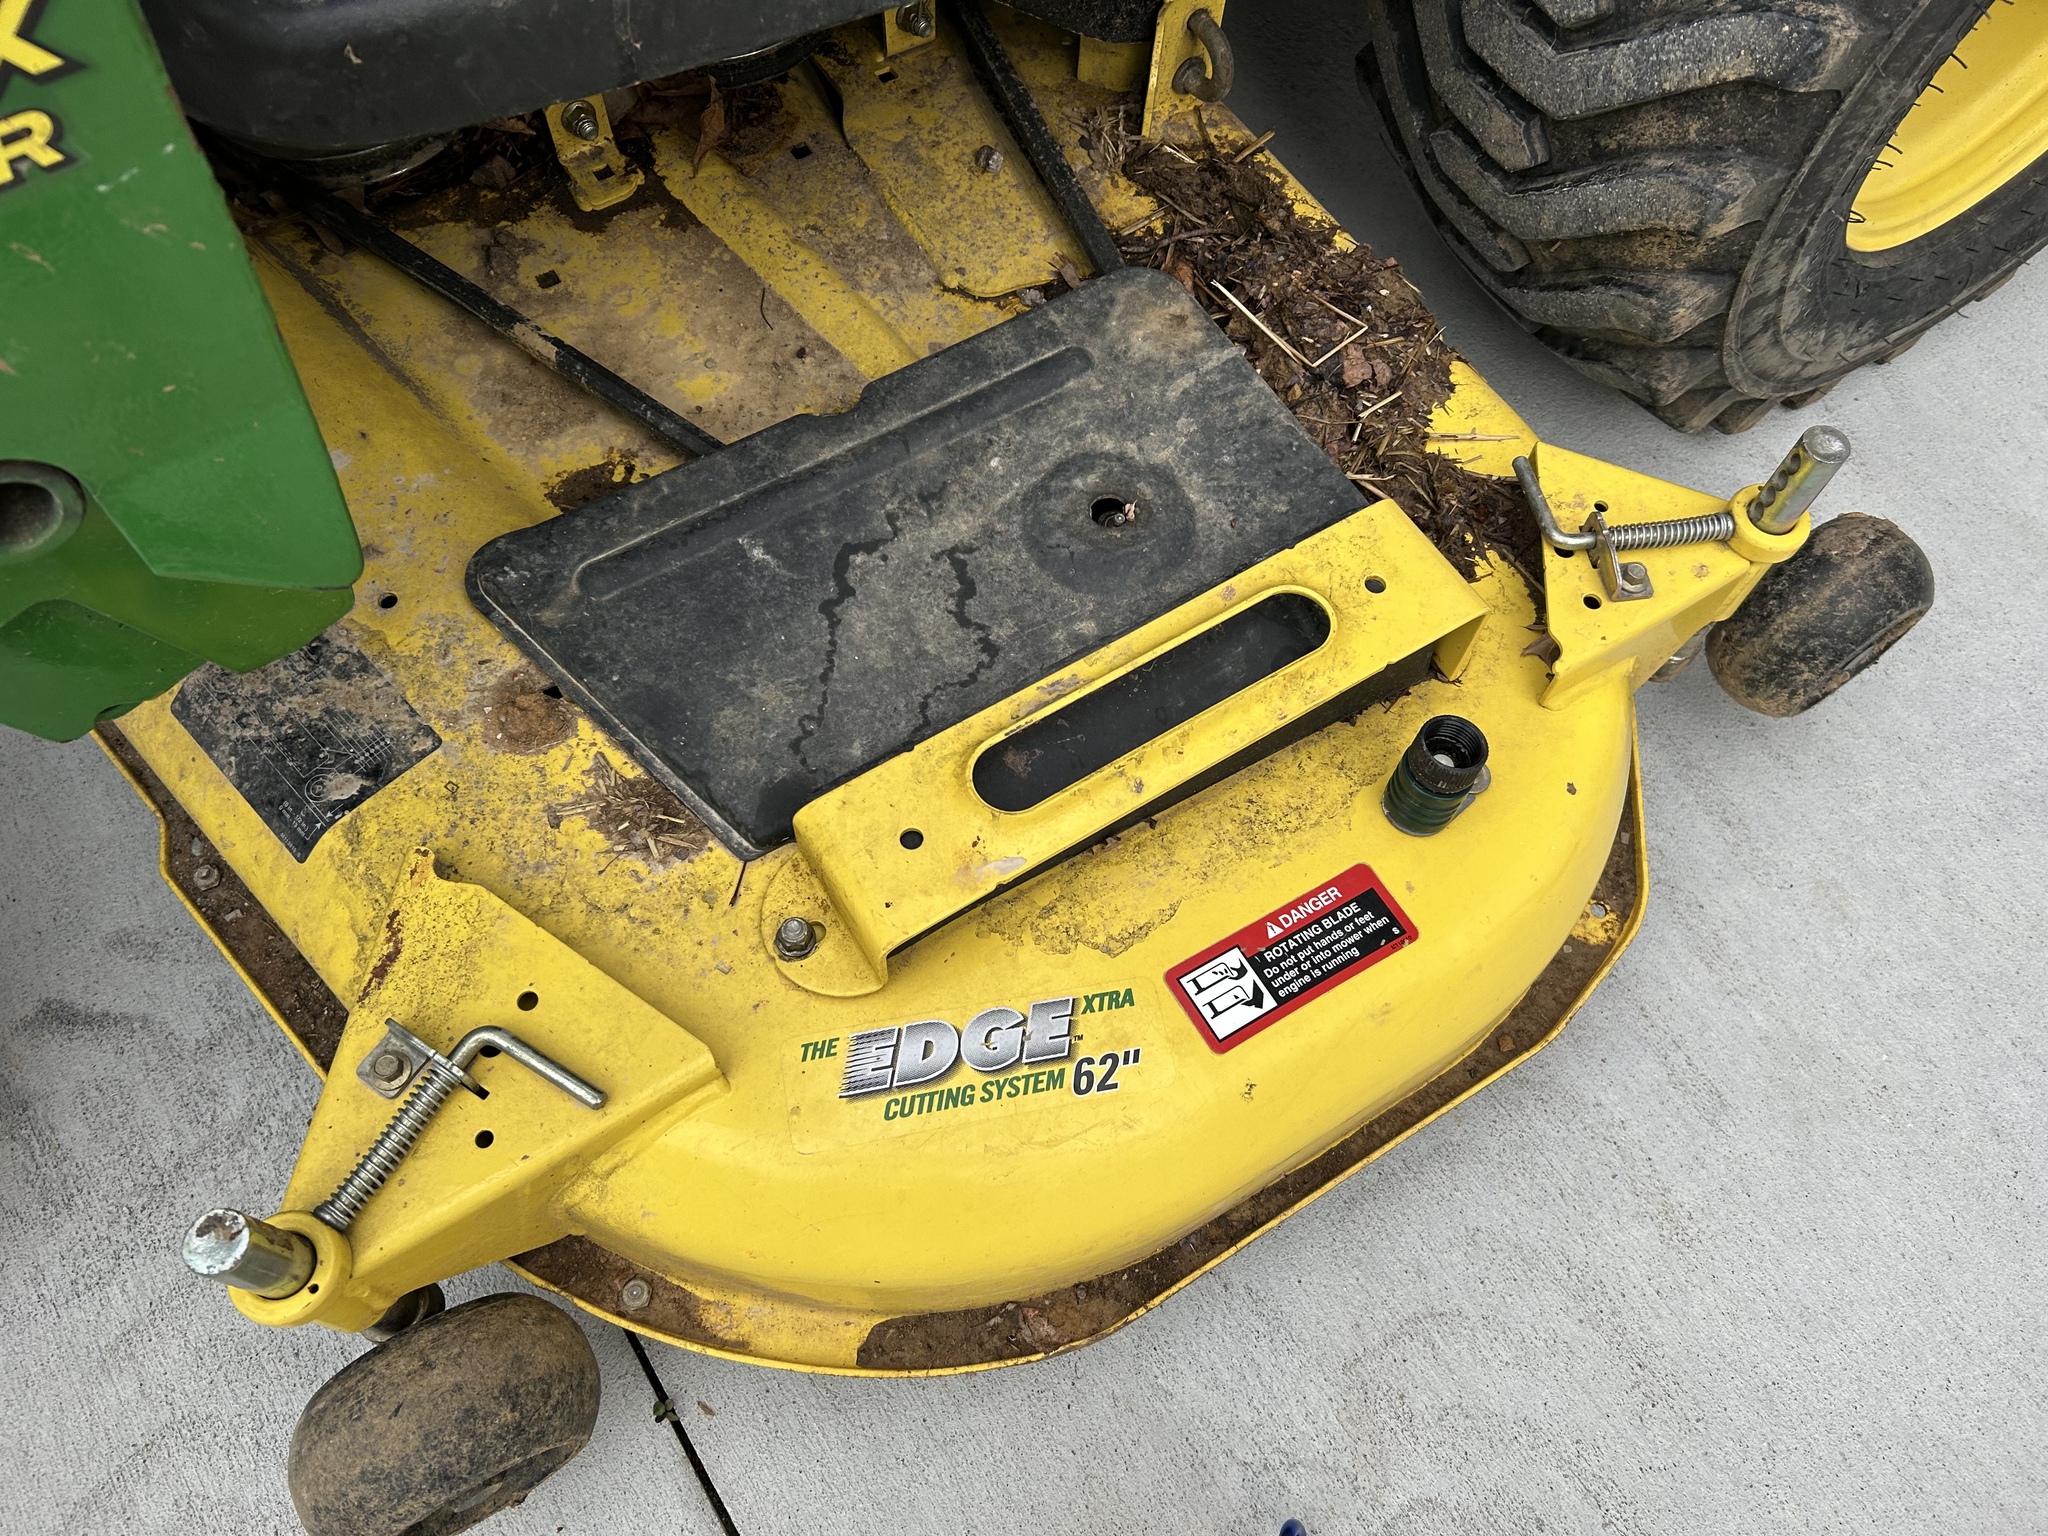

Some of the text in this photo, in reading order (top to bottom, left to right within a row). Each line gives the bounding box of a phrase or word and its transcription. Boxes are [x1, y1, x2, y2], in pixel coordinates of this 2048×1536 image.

[1263, 902, 1361, 962] ROTATING BLADE
[1278, 886, 1342, 929] DANGER
[1263, 911, 1375, 979] Do not put hands or feet
[1270, 916, 1390, 988] under or into mower when
[1278, 947, 1360, 999] engine is running
[801, 1038, 840, 1063] THE
[838, 996, 1075, 1099] EDGE
[1081, 988, 1135, 1015] XTRA
[883, 1047, 1142, 1122] CUTTING SYSTEM 62"
